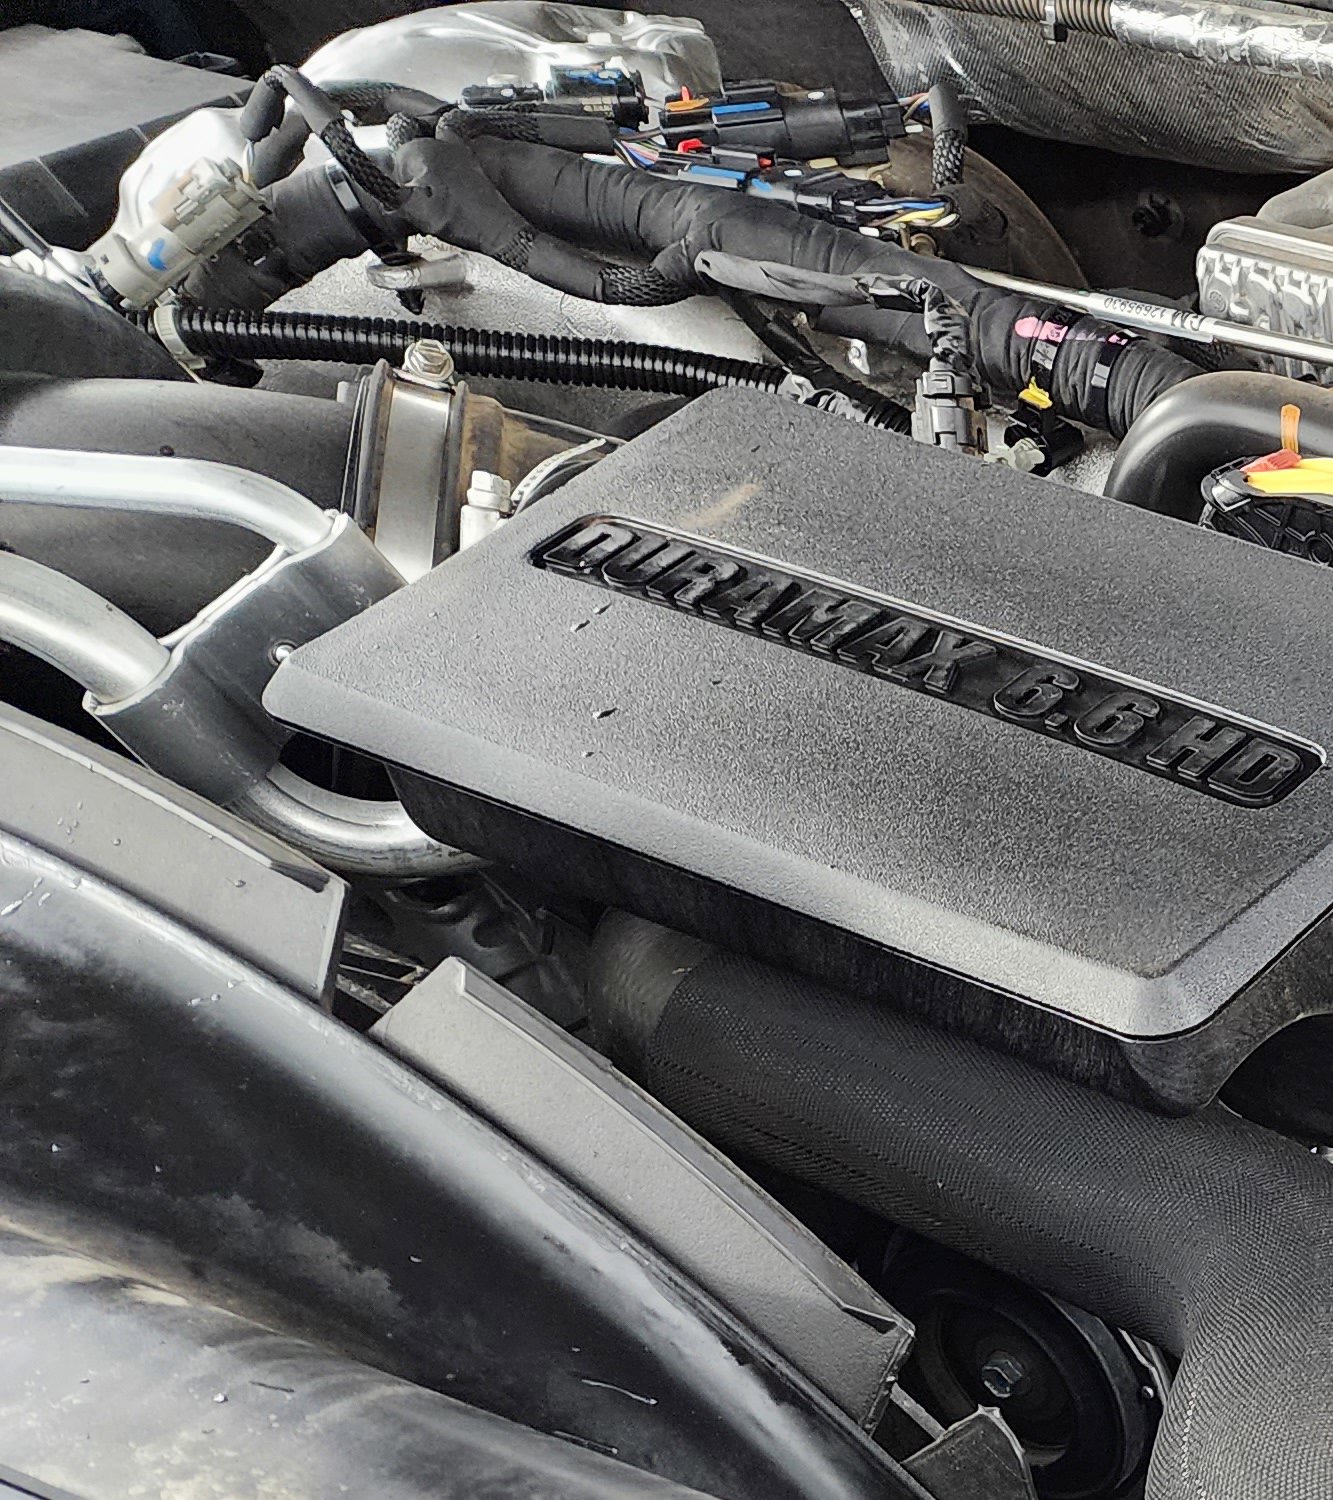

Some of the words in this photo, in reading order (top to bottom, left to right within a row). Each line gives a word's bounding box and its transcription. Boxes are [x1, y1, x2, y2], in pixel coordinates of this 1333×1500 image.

[543, 520, 998, 694] DURAMAX
[991, 661, 1163, 749] 6.6
[1146, 712, 1305, 800] HD
